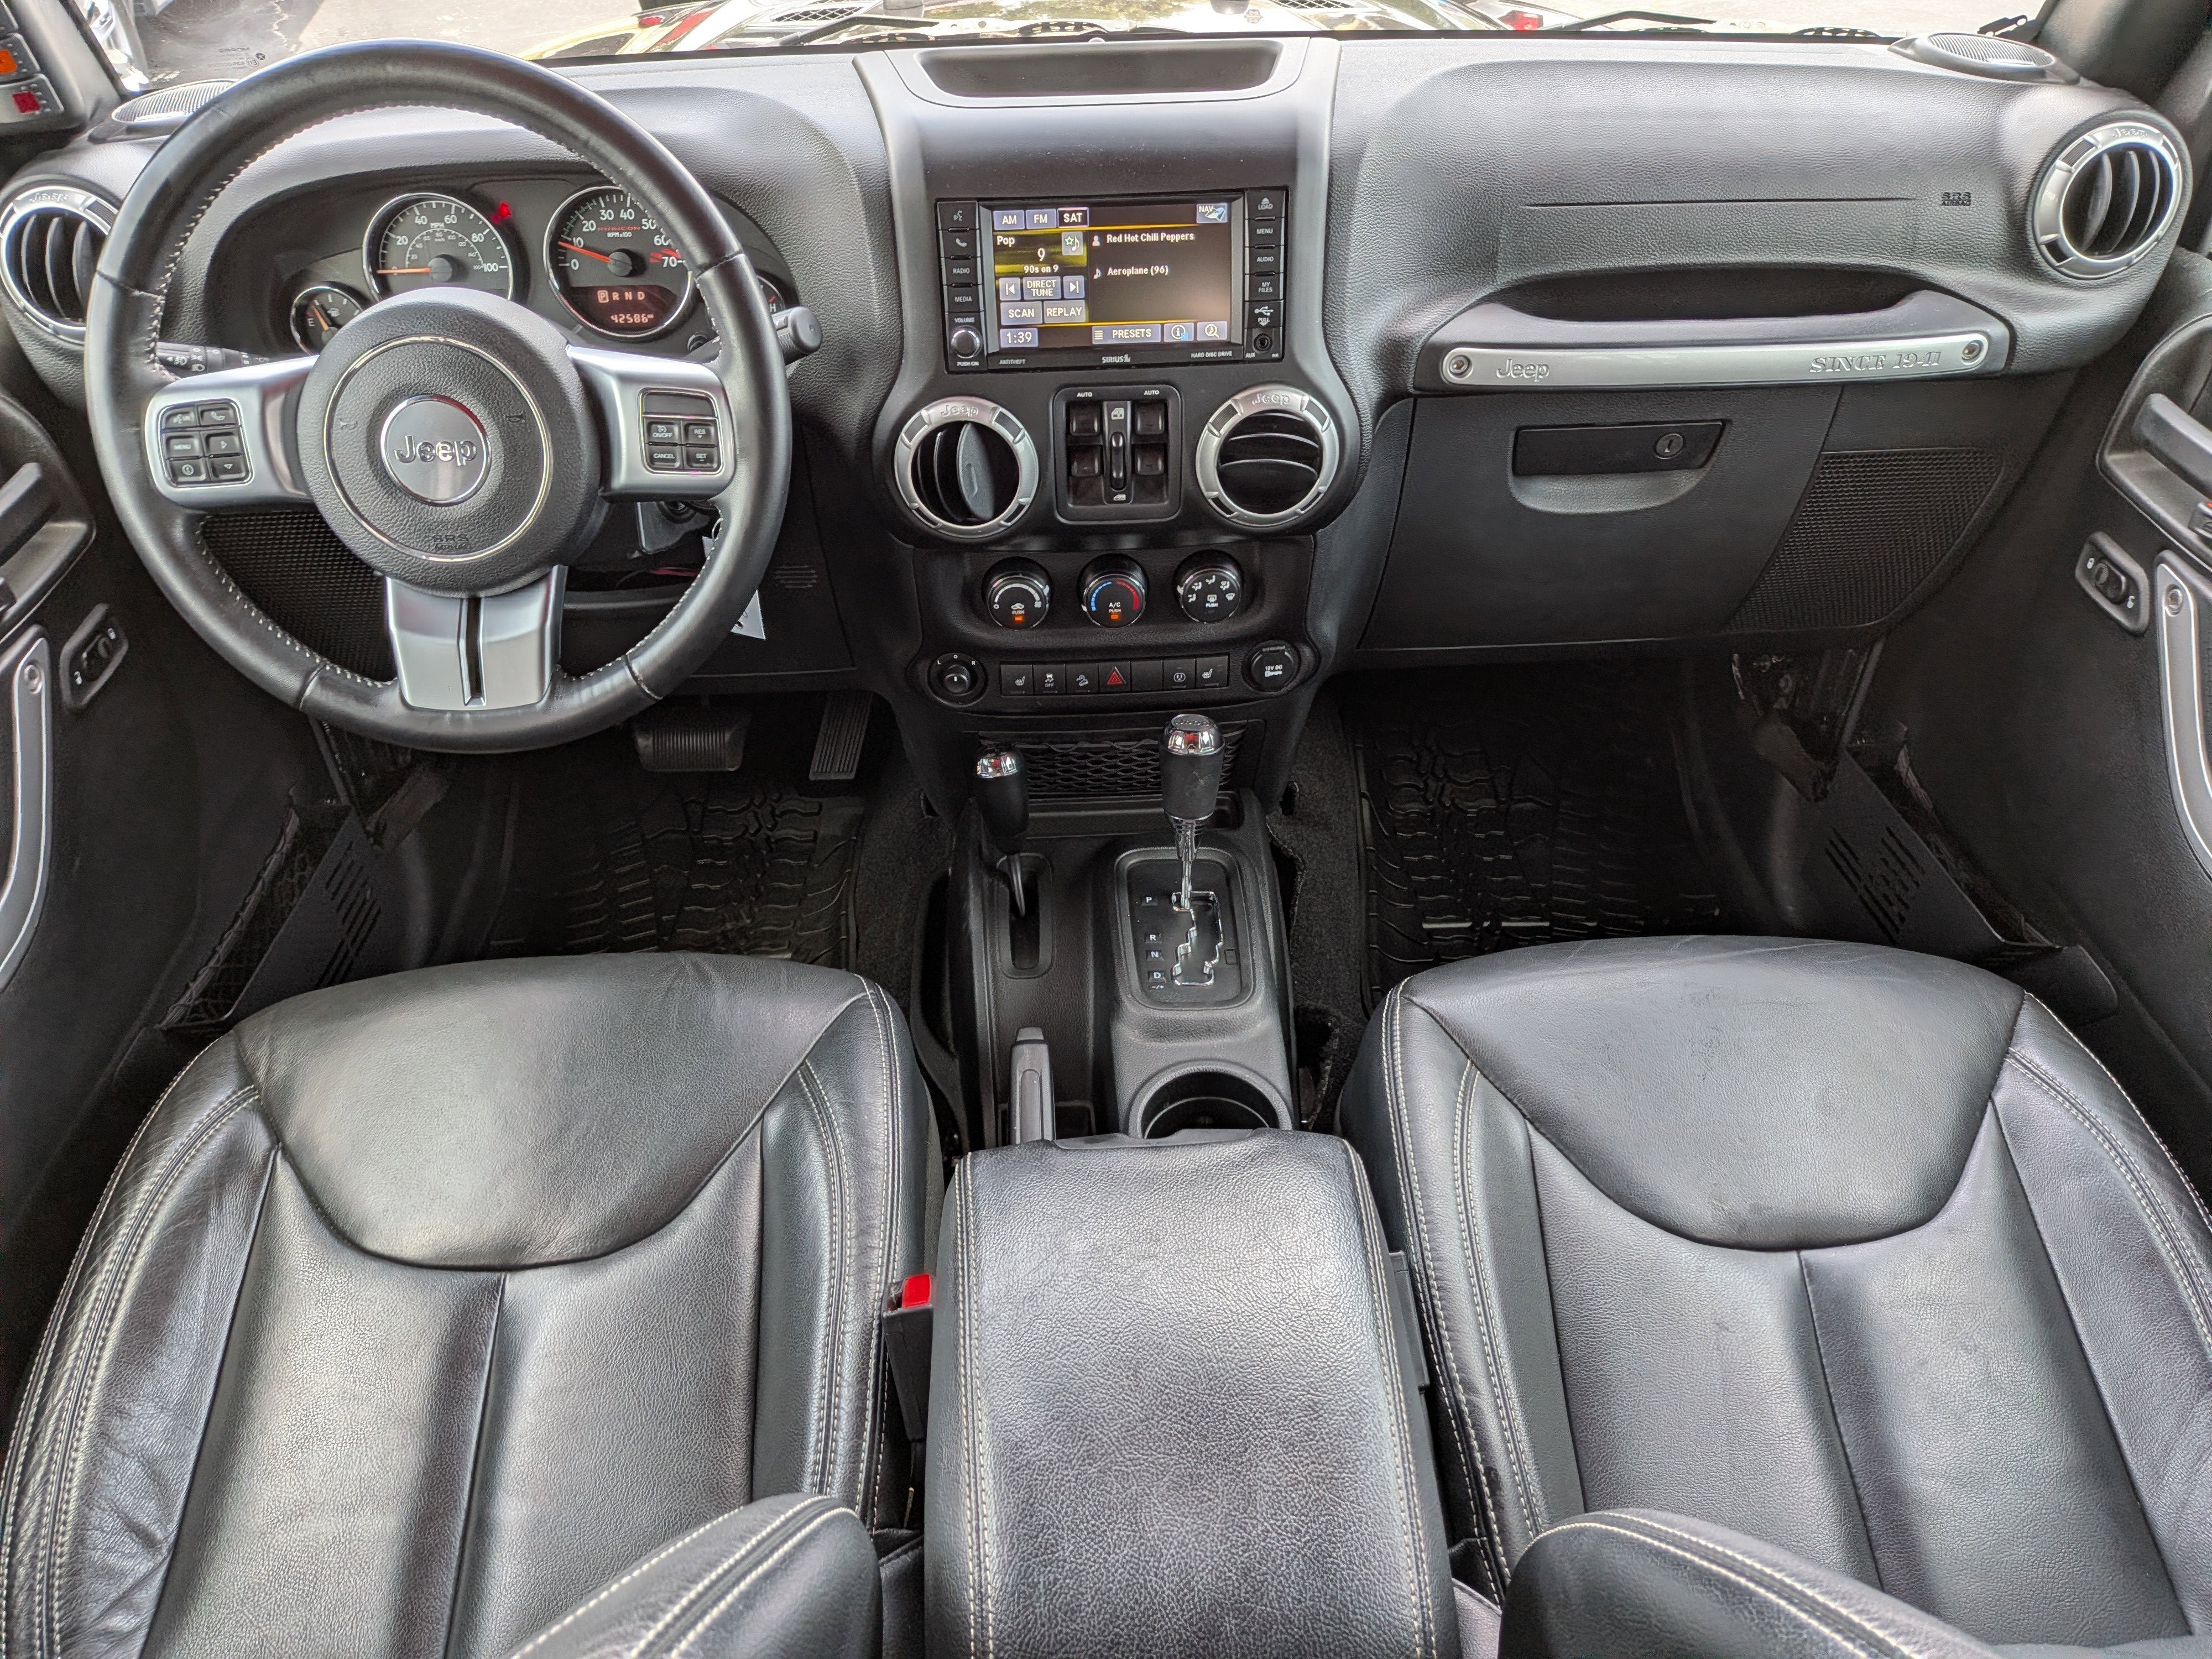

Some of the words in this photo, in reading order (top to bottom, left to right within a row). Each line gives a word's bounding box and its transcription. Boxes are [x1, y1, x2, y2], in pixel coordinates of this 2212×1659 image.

[444, 215, 457, 224] 60
[599, 209, 614, 220] 30
[619, 208, 635, 220] 40
[1034, 213, 1048, 223] FM
[1063, 212, 1083, 222] SAT
[415, 216, 428, 225] 40
[641, 218, 657, 230] 50
[1002, 215, 1018, 225] AM
[582, 220, 596, 232] 20
[396, 236, 409, 246] 20
[471, 233, 484, 242] 80
[572, 237, 584, 248] 10
[654, 234, 669, 246] 60
[997, 236, 1015, 248] Pop
[1107, 234, 1122, 243] Red
[1124, 233, 1139, 242] Hot
[1140, 233, 1159, 242] Chili
[1160, 232, 1194, 243] Peppers
[1037, 248, 1046, 262] 9
[483, 263, 499, 272] 100
[571, 259, 579, 270] 0
[661, 256, 677, 268] 70
[1024, 265, 1039, 274] 90s
[1107, 265, 1148, 276] Aeroplane
[1150, 265, 1169, 276] (96)
[1026, 280, 1057, 289] DIRECT
[612, 292, 619, 301] R
[624, 291, 633, 300] N
[637, 291, 645, 300] D
[769, 303, 776, 312] H
[1046, 306, 1082, 317] REPLAY
[611, 313, 648, 324] 42586
[1008, 309, 1035, 319] SCAN
[307, 318, 315, 327] E
[1006, 332, 1032, 344] 1:39
[1113, 328, 1151, 338] PRESETS
[1809, 354, 1887, 373] SINCE
[1892, 351, 1942, 369] 1941
[1496, 358, 1550, 382] Jeep
[1251, 393, 1290, 406] Jeep
[940, 405, 979, 417] Jeep
[394, 435, 477, 467] Jeep
